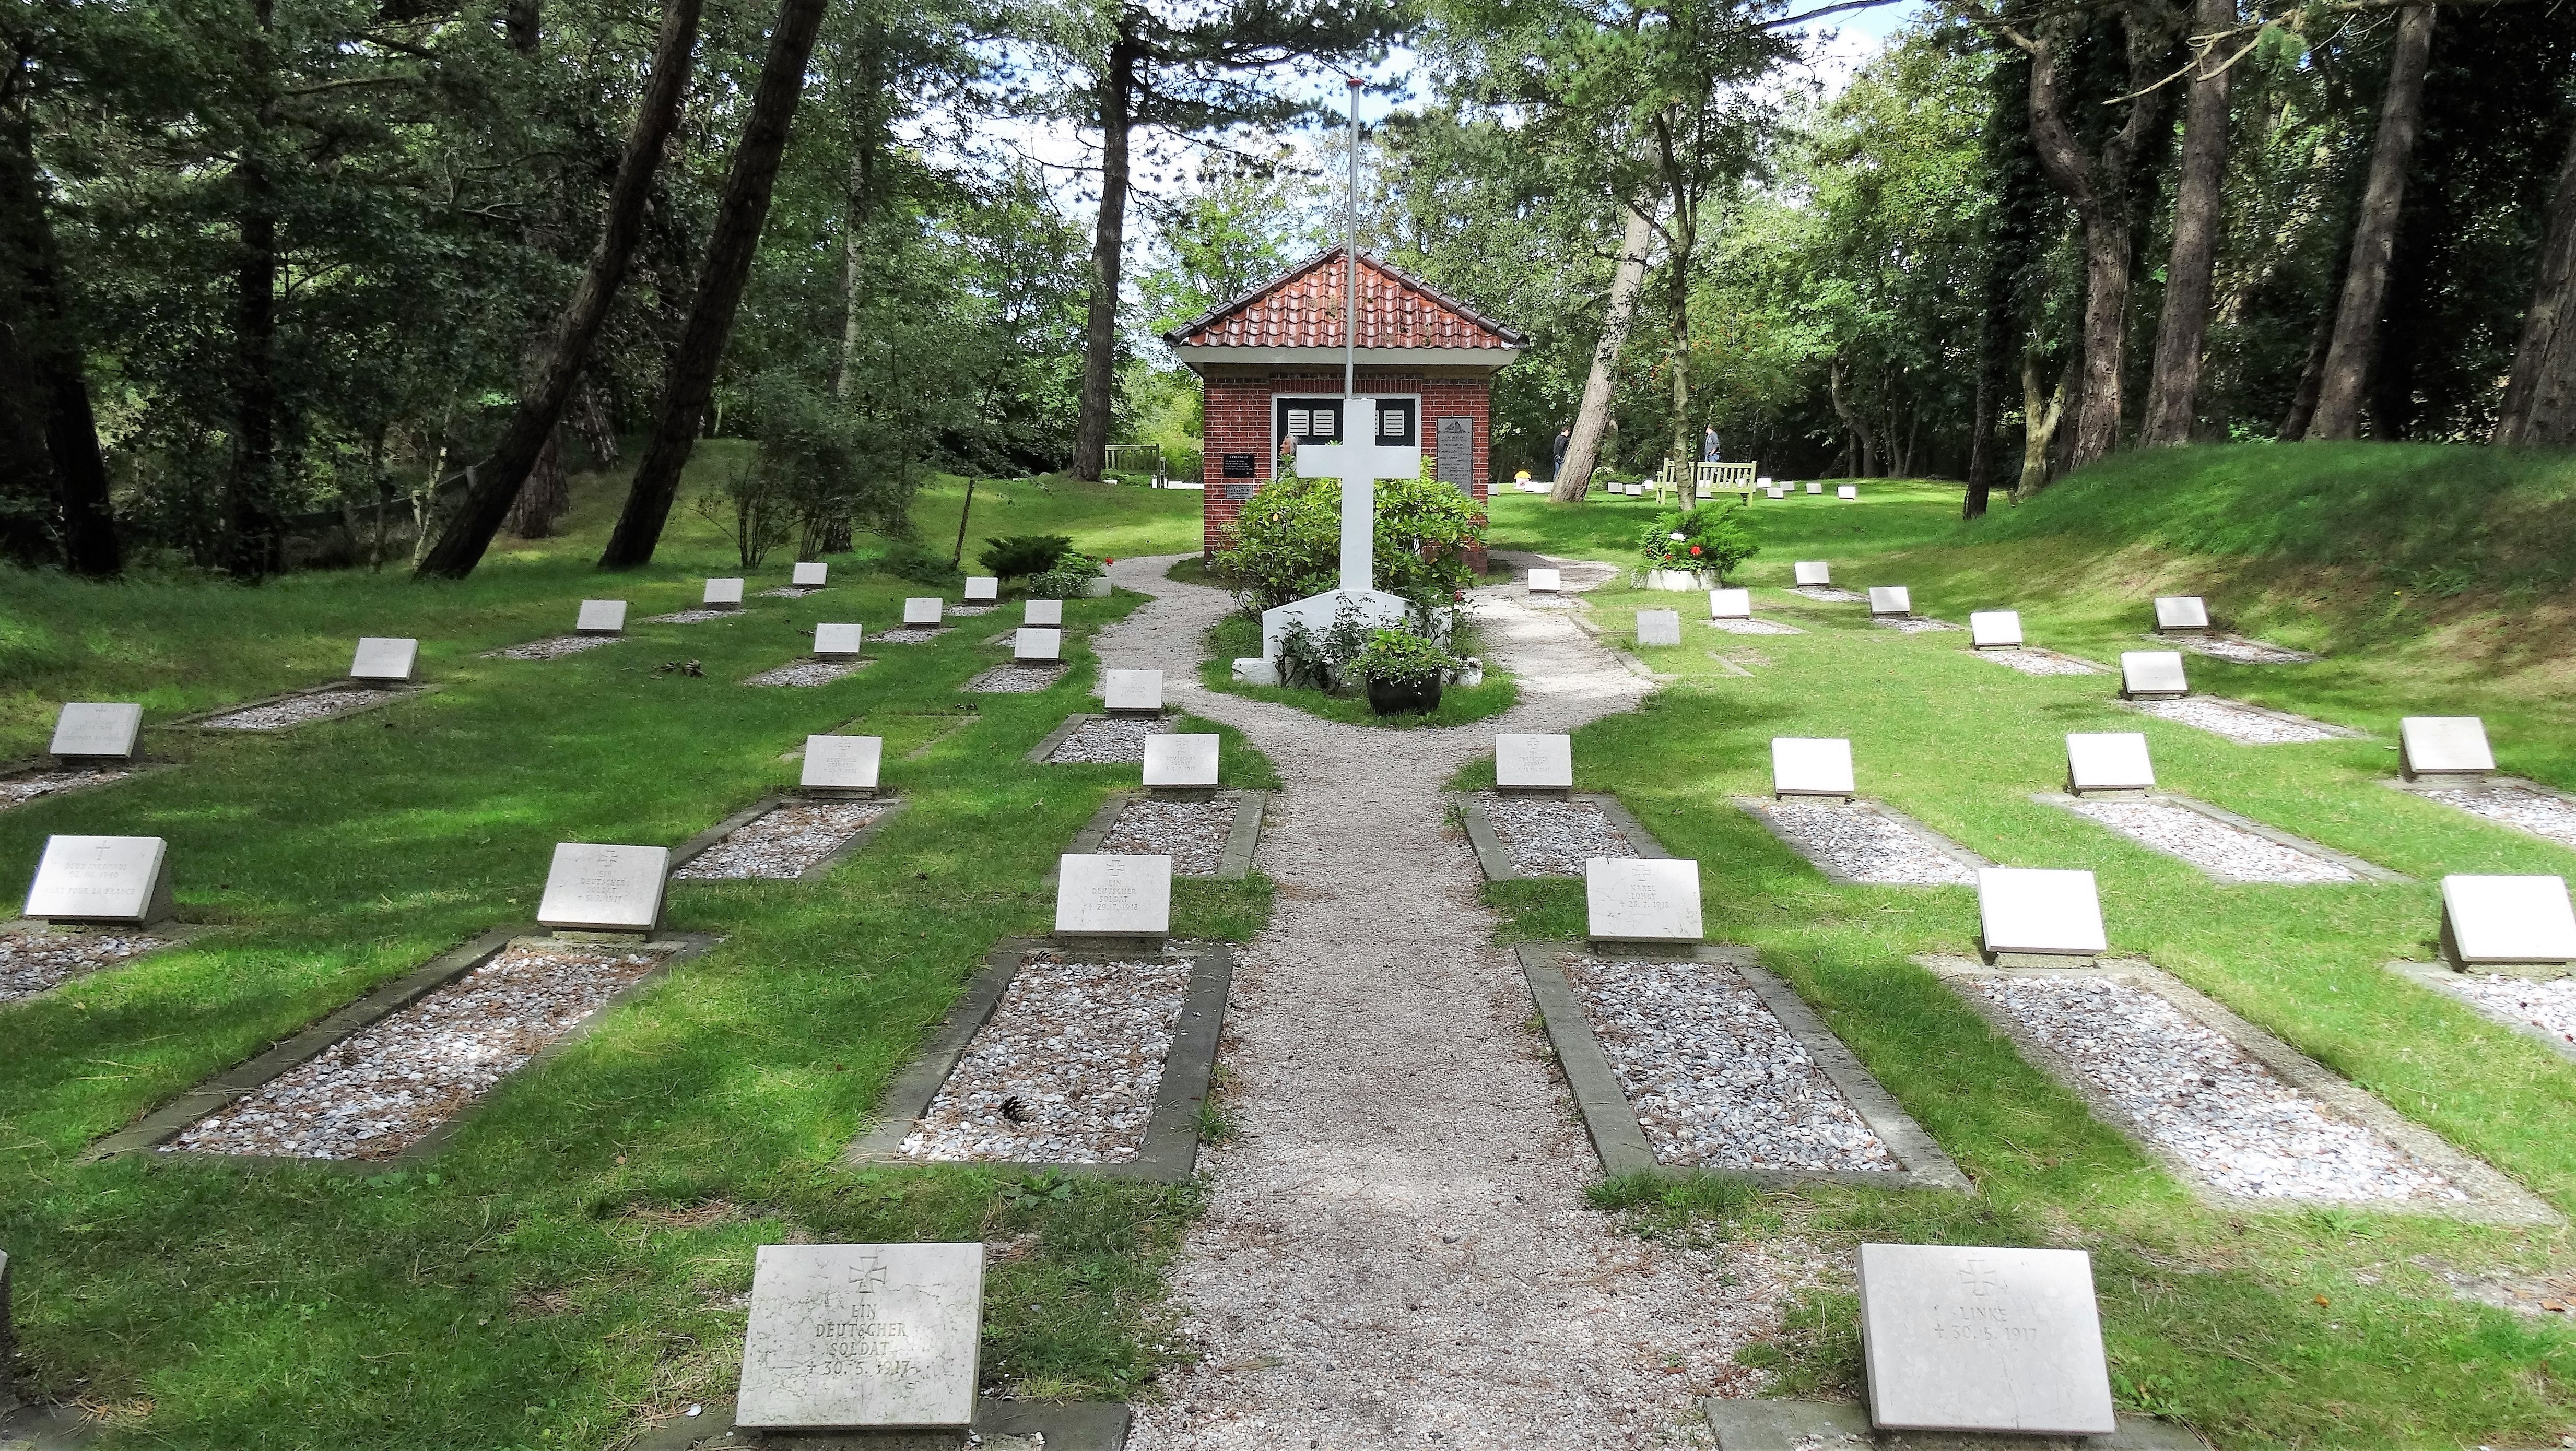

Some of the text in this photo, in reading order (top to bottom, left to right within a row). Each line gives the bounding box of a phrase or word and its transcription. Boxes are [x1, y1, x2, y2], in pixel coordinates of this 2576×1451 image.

[581, 878, 626, 887] DEUTSCHER
[851, 1304, 877, 1319] EIN
[1959, 1306, 2007, 1323] LINKE
[815, 1323, 908, 1337] DEUTSCHER
[1951, 1325, 1977, 1339] 30.
[2005, 1327, 2037, 1341] 1917
[829, 1341, 890, 1356] SOLDAT
[823, 1361, 848, 1375] 30.
[877, 1360, 910, 1377] 1917
